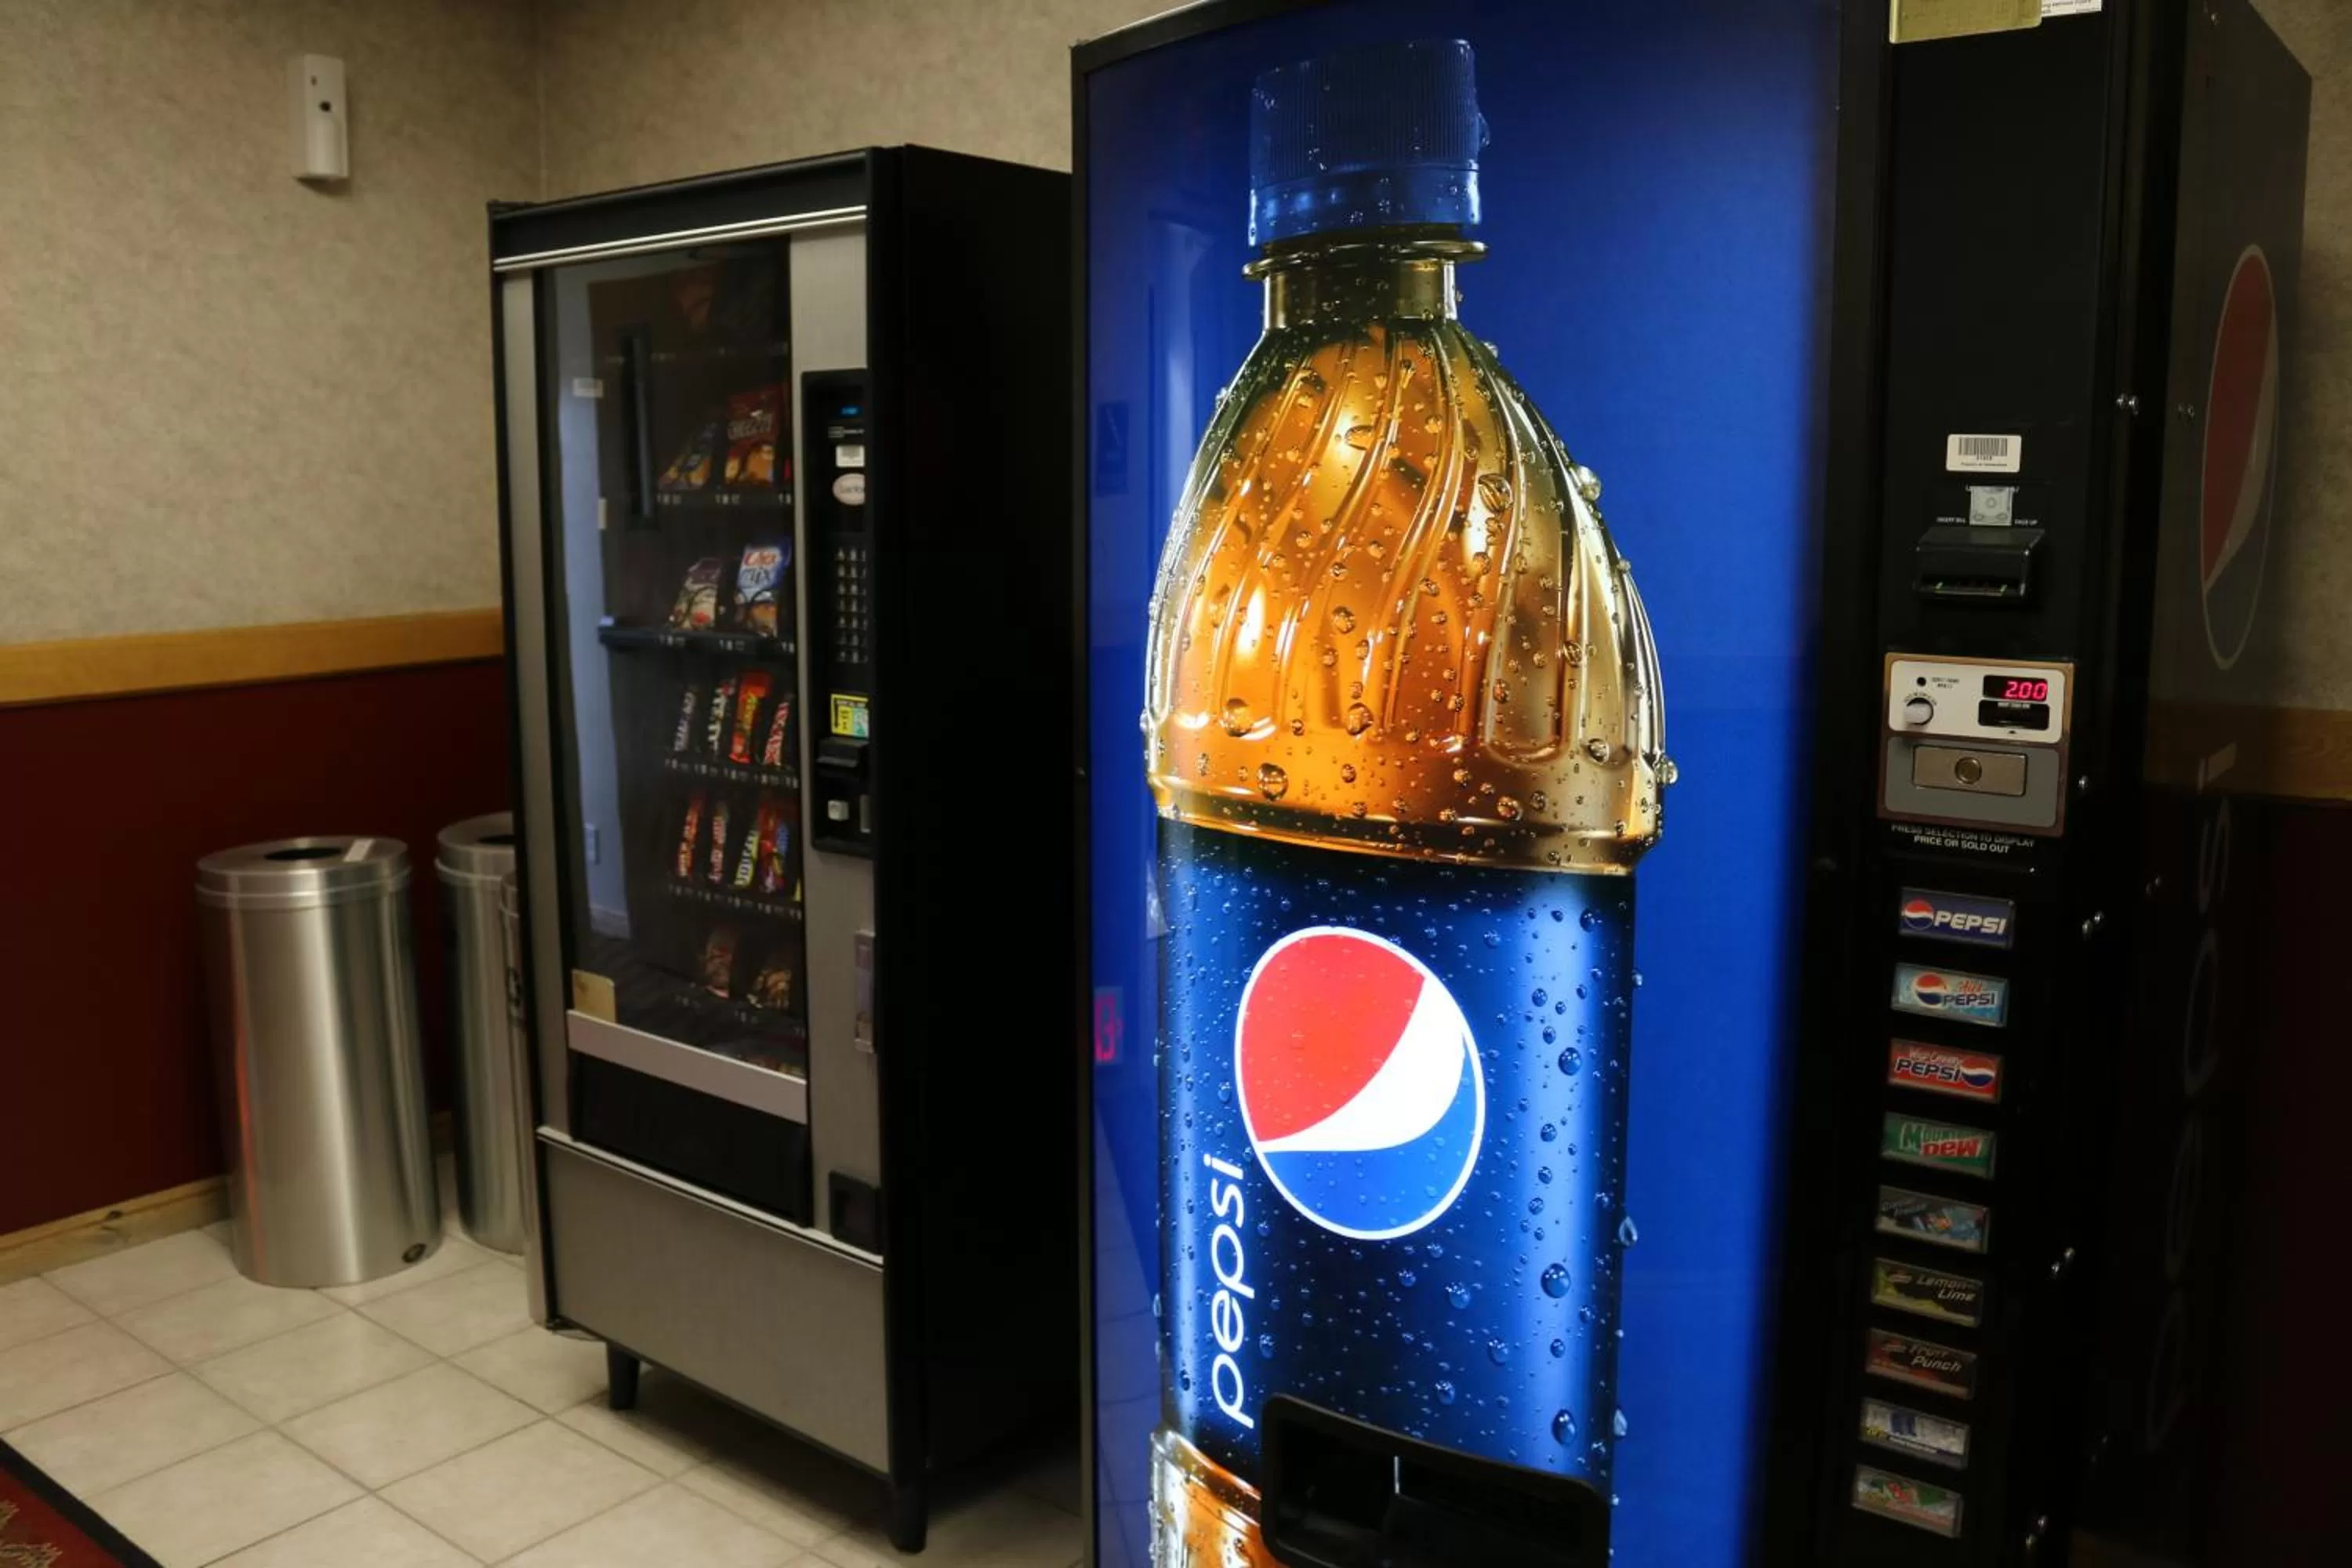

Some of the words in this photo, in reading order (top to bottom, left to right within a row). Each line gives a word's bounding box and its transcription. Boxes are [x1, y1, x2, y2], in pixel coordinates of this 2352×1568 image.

[1891, 824, 1922, 835] PRESS
[1924, 826, 1978, 841] SELECTION
[1980, 833, 1992, 842] TO
[1994, 835, 2035, 848] DISPLAY
[1914, 835, 1942, 847] PRICE
[1944, 838, 1959, 848] OR
[1961, 840, 1987, 851] SOLD
[1989, 843, 2010, 854] OUT
[1933, 909, 2008, 935] PEPSI
[1942, 993, 1997, 1007] PEPSI
[1895, 1058, 1961, 1083] PEPSI
[1203, 1153, 1254, 1429] pepsi
[1937, 1289, 1976, 1302] Lime
[1911, 1356, 1962, 1373] Punch
